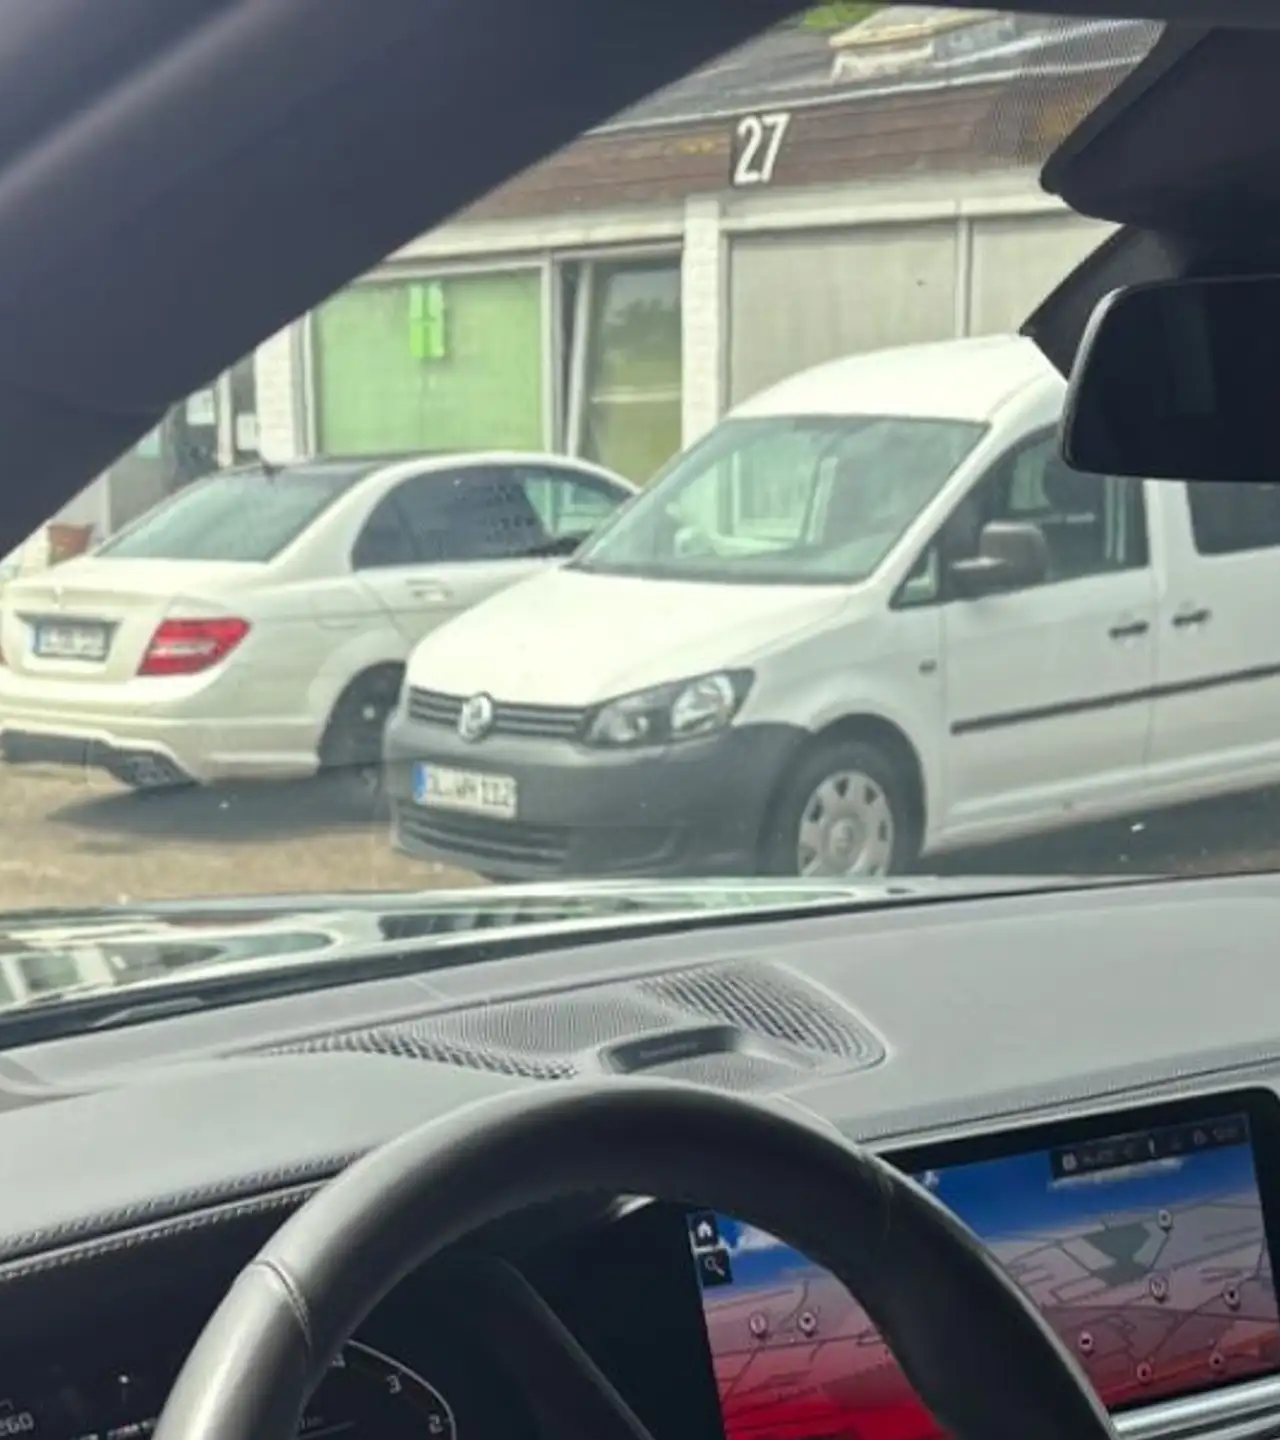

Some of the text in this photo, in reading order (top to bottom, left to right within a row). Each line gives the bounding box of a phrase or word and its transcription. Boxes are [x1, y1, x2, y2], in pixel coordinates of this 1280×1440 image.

[733, 112, 792, 185] 27
[386, 1374, 402, 1394] 3
[428, 1414, 444, 1434] 2
